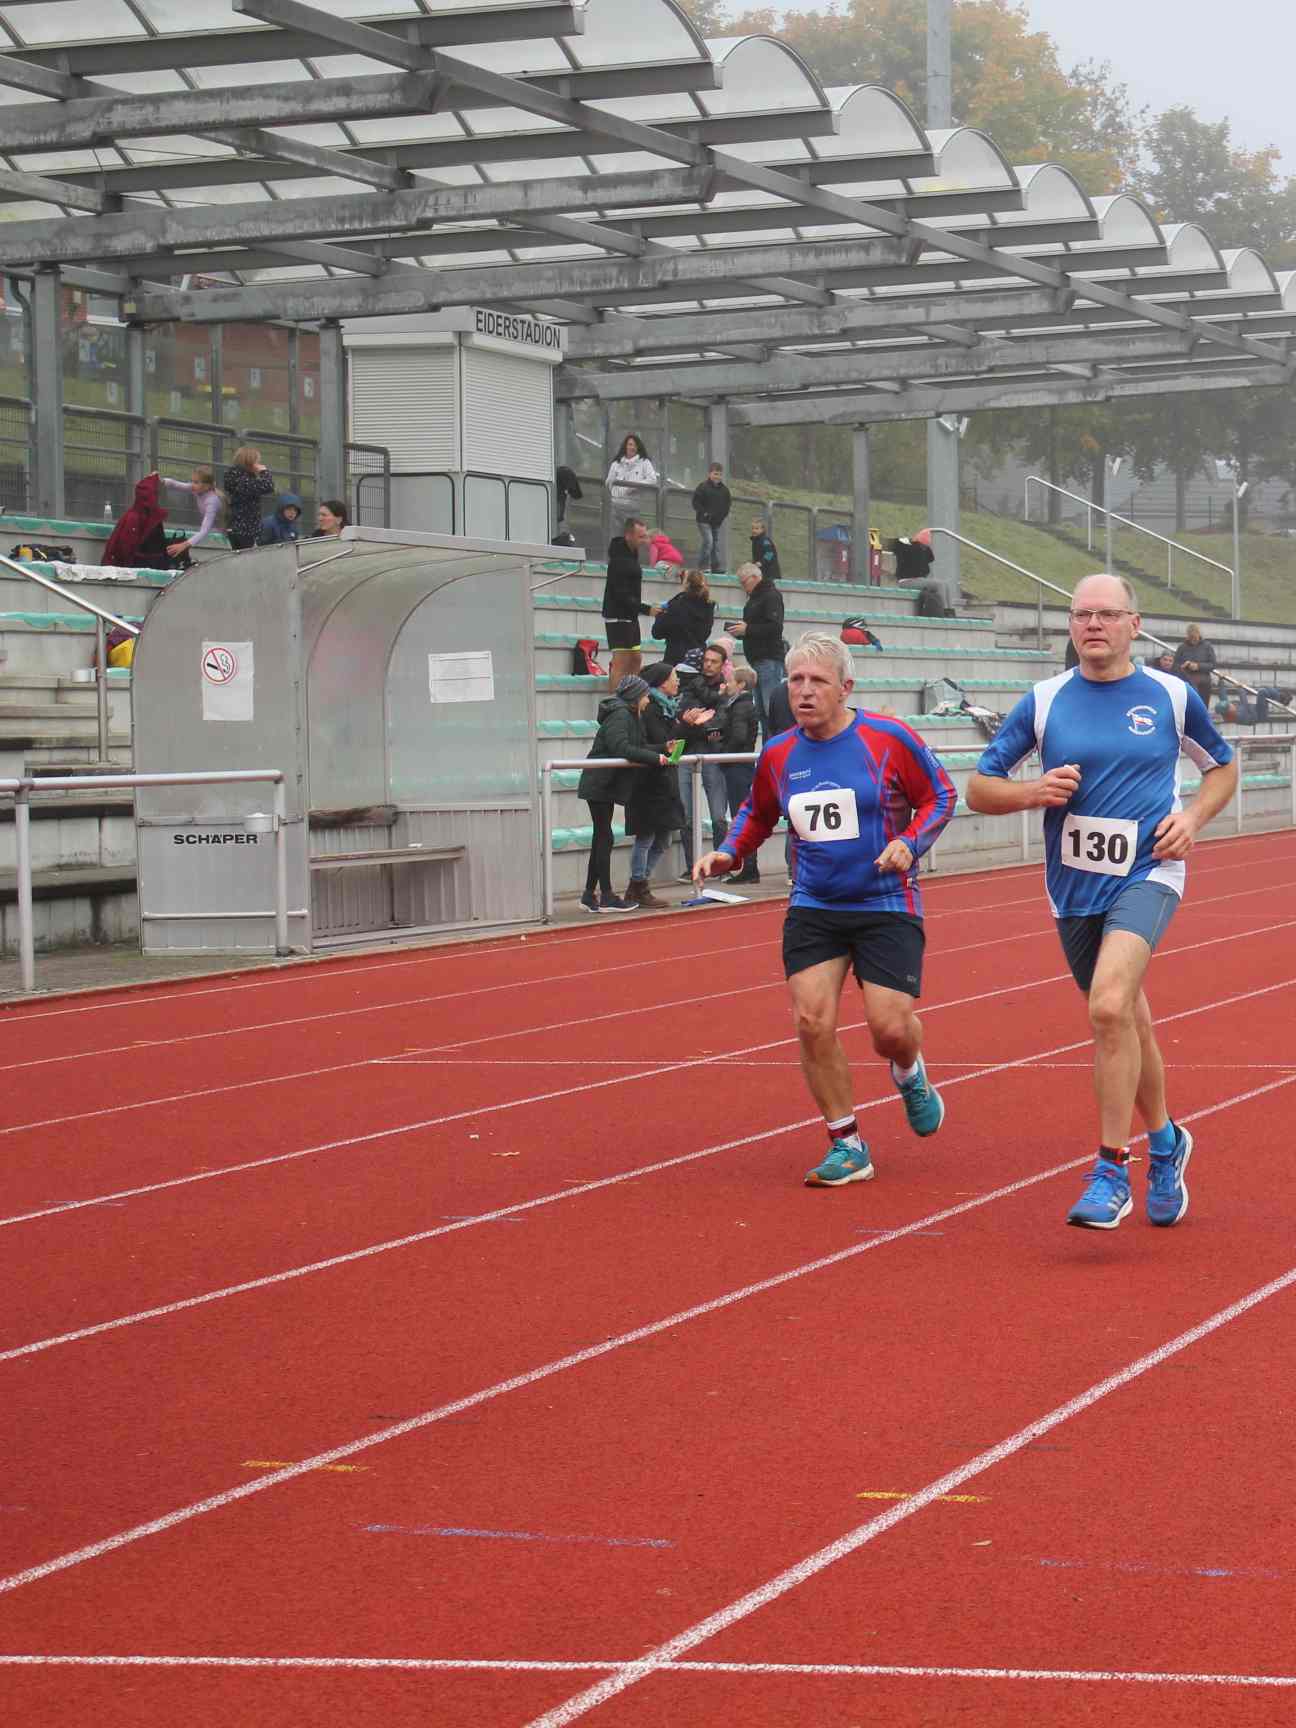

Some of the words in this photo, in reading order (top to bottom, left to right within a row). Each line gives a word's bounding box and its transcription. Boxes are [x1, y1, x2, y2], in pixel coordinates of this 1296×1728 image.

[475, 309, 560, 349] EIDERSTADION
[804, 802, 842, 831] 76
[1068, 829, 1128, 864] 130
